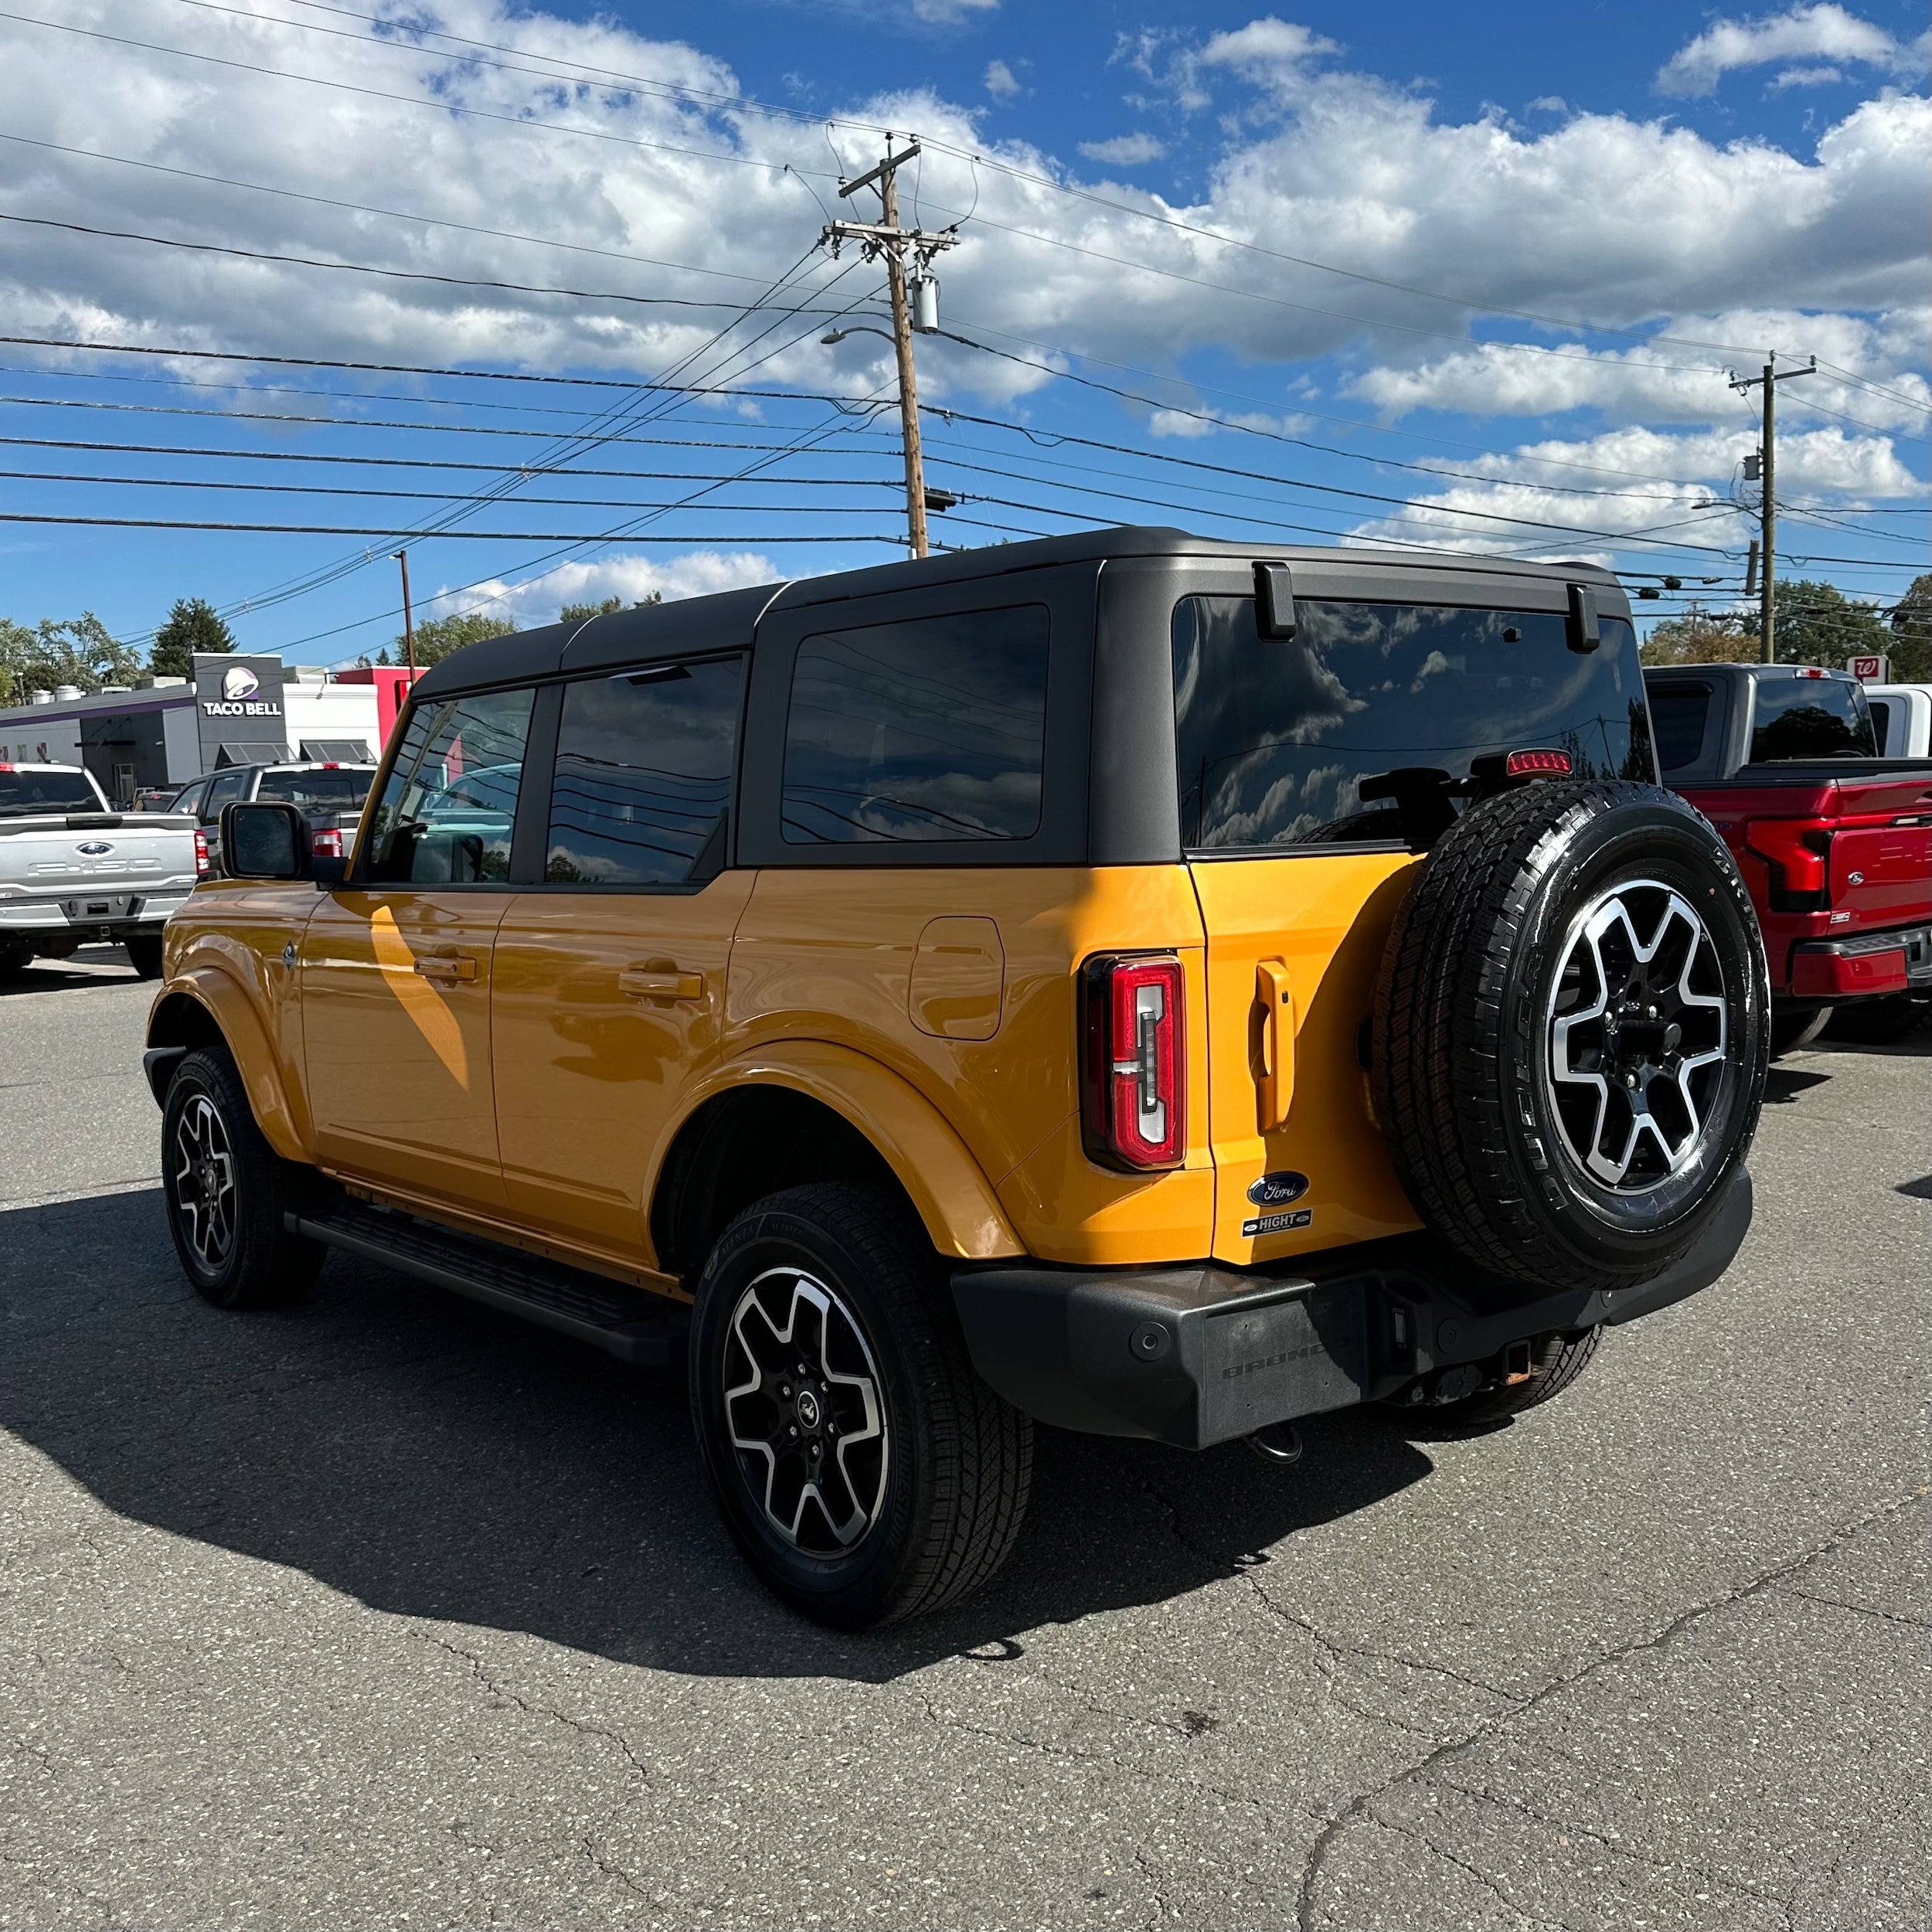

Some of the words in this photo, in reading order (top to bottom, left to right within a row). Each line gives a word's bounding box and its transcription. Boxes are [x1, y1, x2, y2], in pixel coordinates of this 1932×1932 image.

[1856, 659, 1876, 675] W
[203, 702, 243, 716] TACO
[245, 702, 281, 716] BELL
[1264, 1181, 1297, 1200] Ford
[1258, 1213, 1297, 1230] HIGHT
